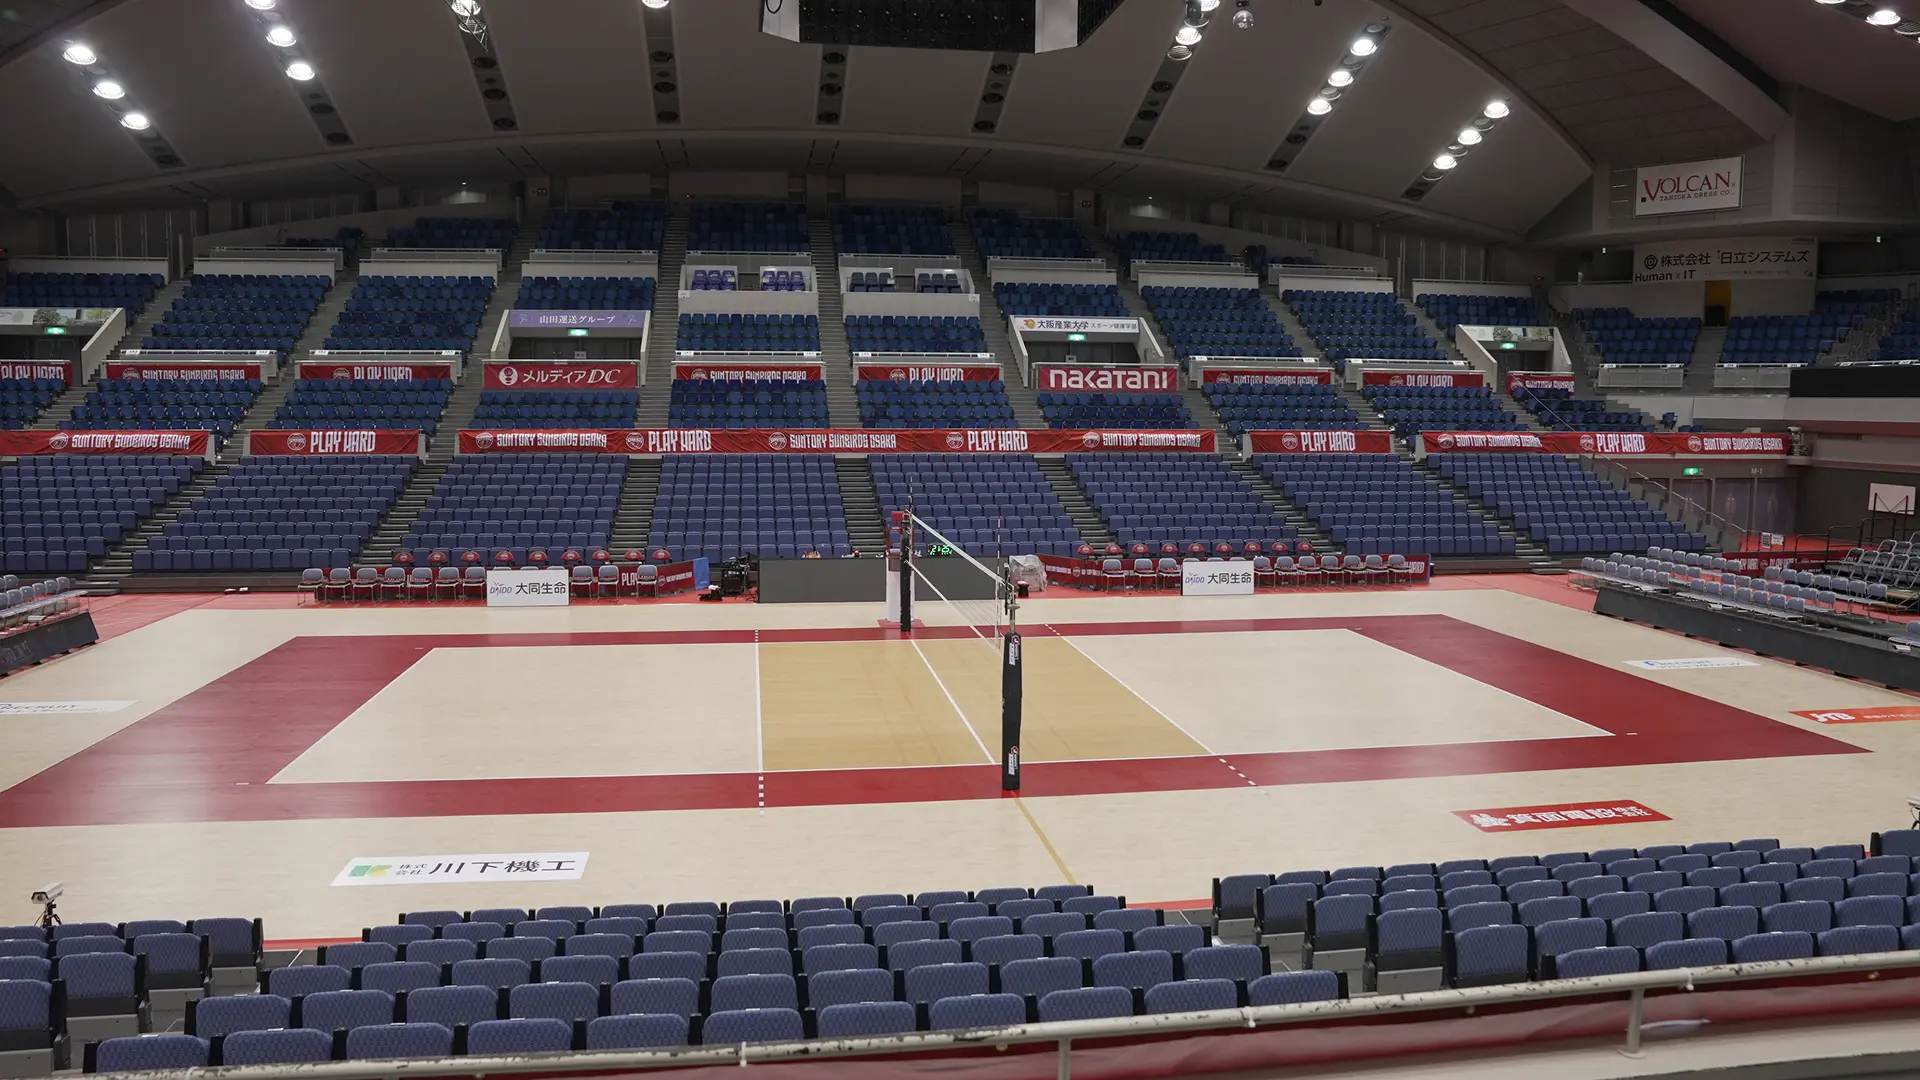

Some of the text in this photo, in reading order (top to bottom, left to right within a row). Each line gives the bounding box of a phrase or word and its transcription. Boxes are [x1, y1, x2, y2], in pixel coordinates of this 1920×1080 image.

[1643, 171, 1731, 202] VOLCAN
[1661, 249, 1810, 267] 株式会社 日立システムズ
[1634, 271, 1673, 283] Human
[1684, 269, 1696, 280] IT
[539, 315, 616, 324] 山田運送グループ
[1037, 320, 1089, 330] 大阪産業大学
[72, 434, 190, 448] SUNTORY SUNBIRDS OSAKA
[310, 431, 376, 452] PLAY HARD
[496, 433, 607, 447] SUNTORY SUNBIRDS OSAKA
[648, 430, 711, 452] PLAY HARD
[790, 433, 897, 448] SUNTORY SUNBIRDS OSAKA
[967, 430, 1028, 451] PLAY HARD
[1102, 433, 1200, 447] SUNTORY SUNBIRDS OSAKA
[1300, 431, 1356, 452] PLAY HARD
[1597, 433, 1645, 453] PLAY HARD
[1207, 571, 1252, 585] 大同生命
[515, 581, 567, 595] 大同生命
[429, 860, 576, 874] 川下機工
